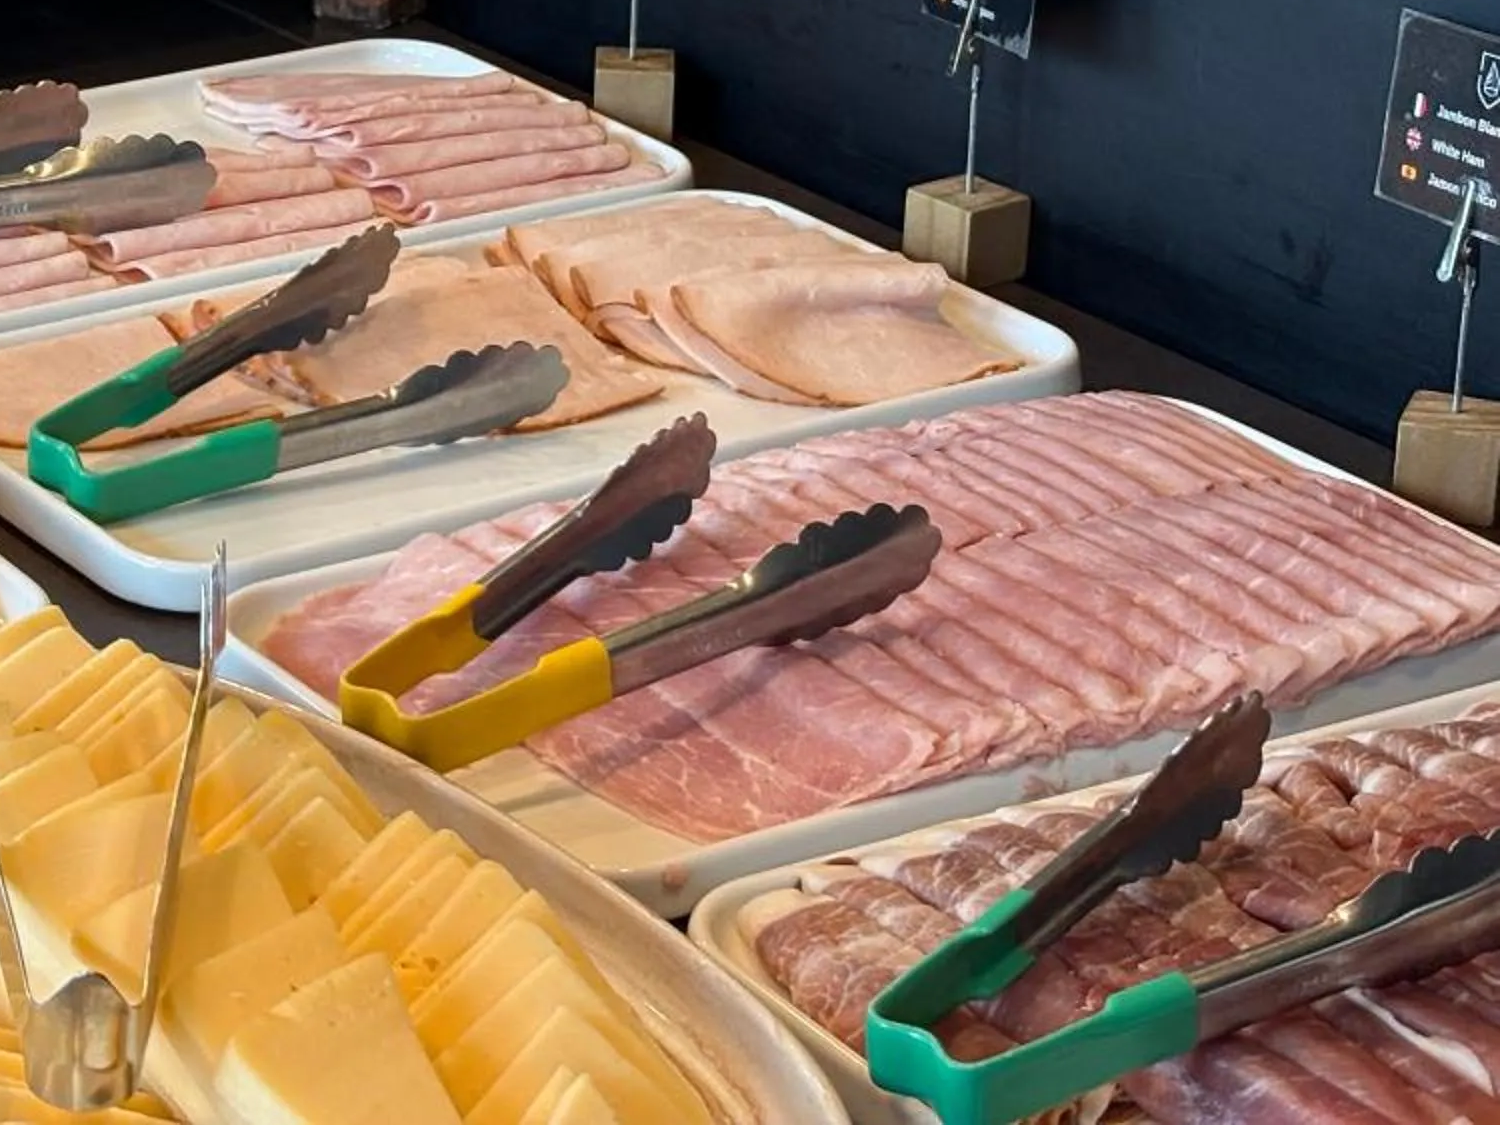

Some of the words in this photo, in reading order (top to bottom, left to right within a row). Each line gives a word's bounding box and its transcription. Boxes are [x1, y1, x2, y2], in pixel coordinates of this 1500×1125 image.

[1437, 103, 1476, 129] Jambon
[1432, 138, 1461, 161] White
[1462, 147, 1485, 169] Ham
